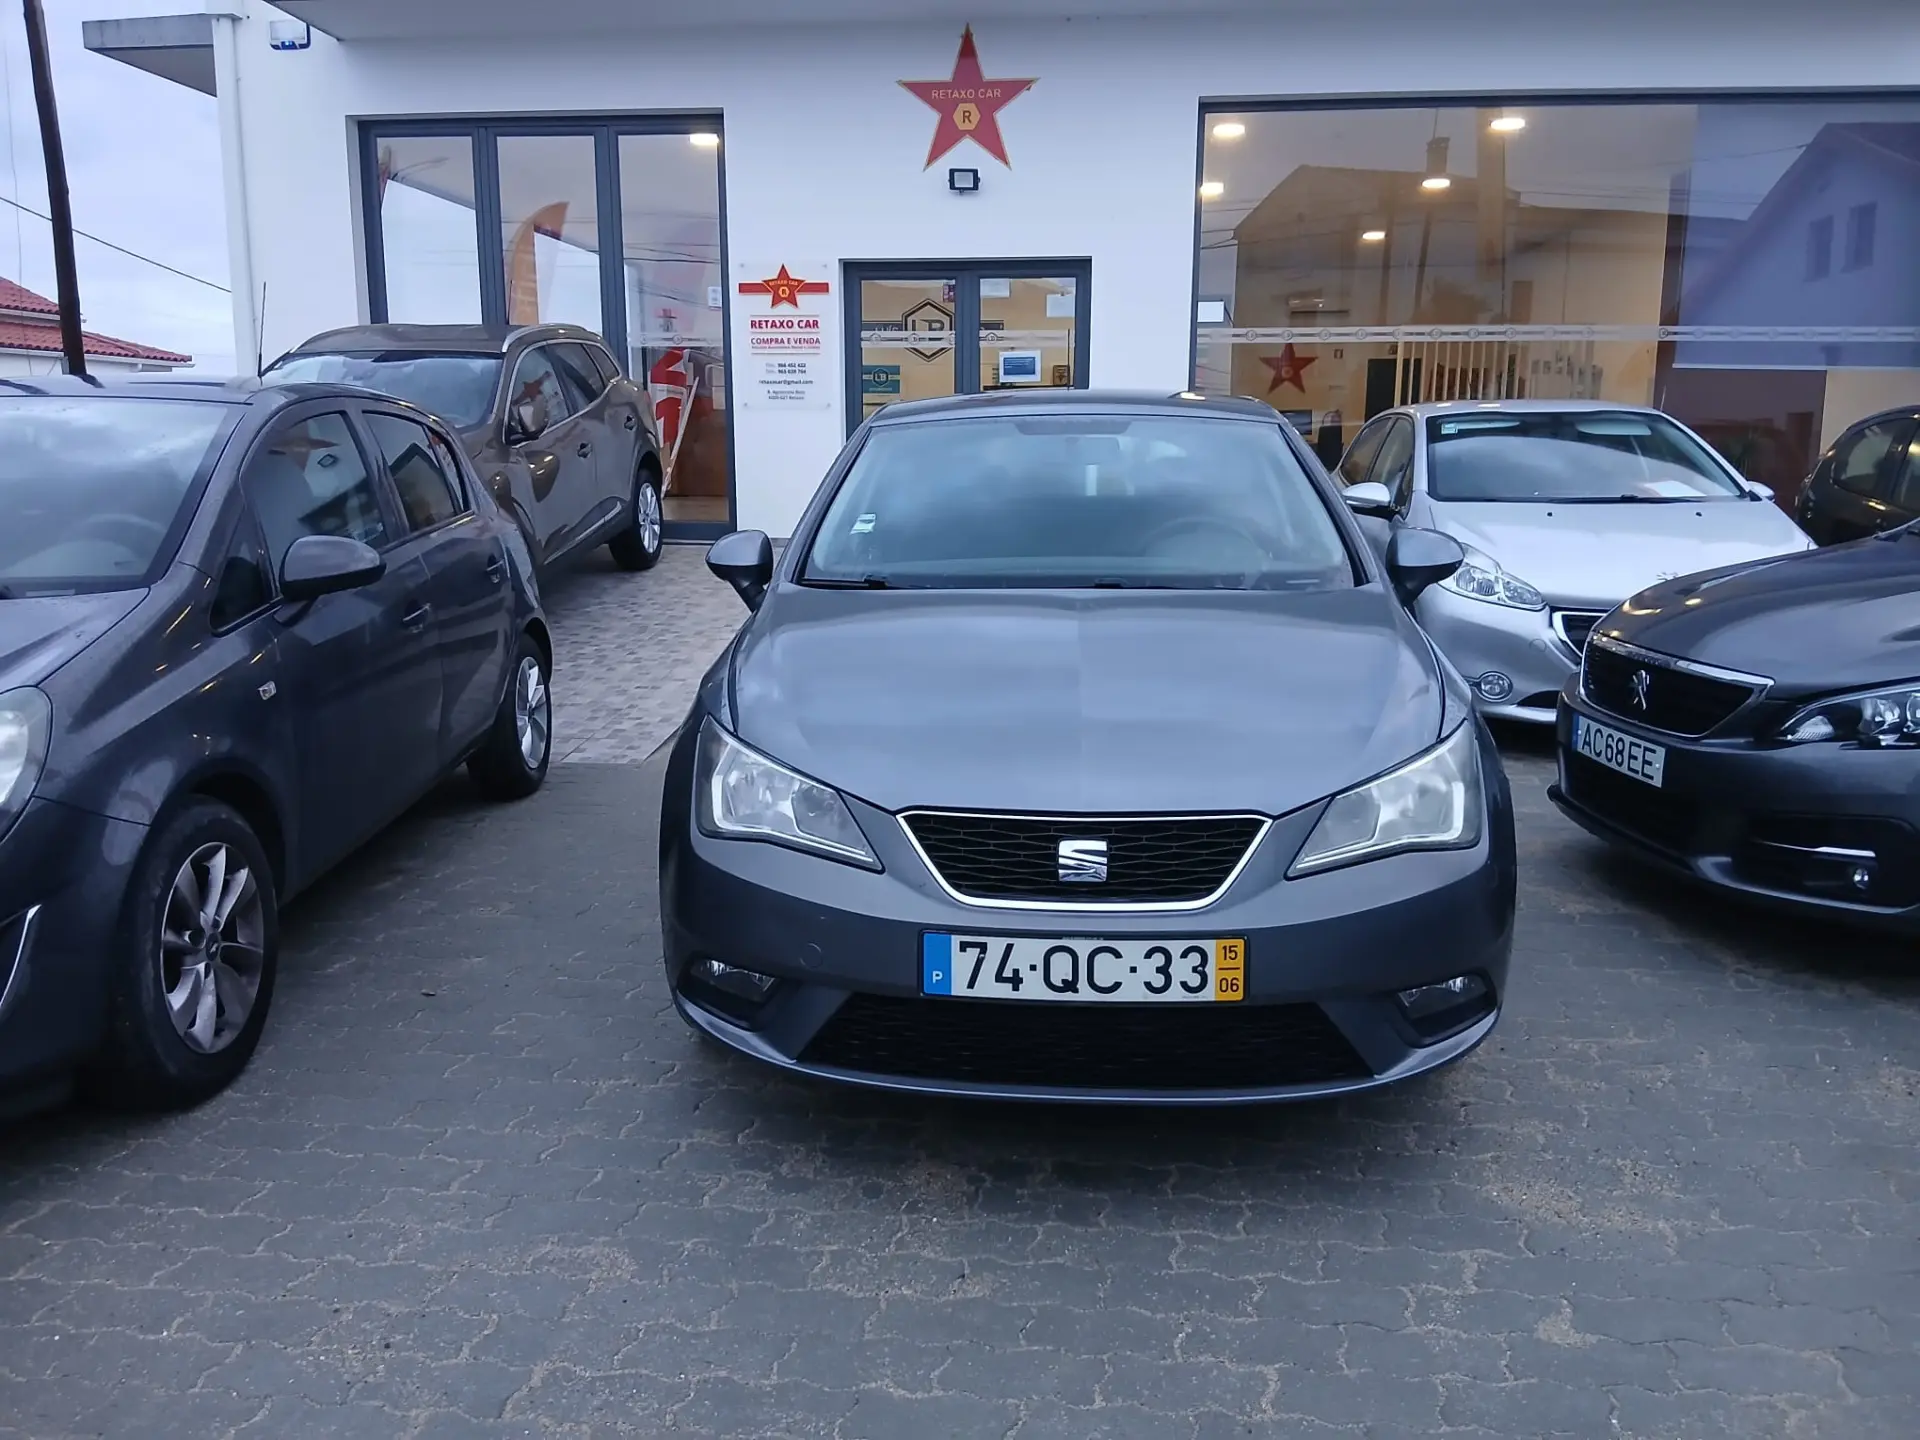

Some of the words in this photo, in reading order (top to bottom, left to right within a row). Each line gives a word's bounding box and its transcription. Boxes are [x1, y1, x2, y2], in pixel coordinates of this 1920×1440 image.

[931, 89, 975, 100] RETAXO
[978, 88, 1002, 98] CAR
[962, 110, 972, 124] R
[750, 319, 794, 329] RETAXO
[797, 319, 819, 329] CAR
[751, 337, 785, 345] COMPRA
[787, 337, 792, 345] E
[793, 337, 821, 345] VENDA
[932, 970, 943, 984] P
[1221, 944, 1239, 961] 15
[1218, 977, 1240, 993] 06
